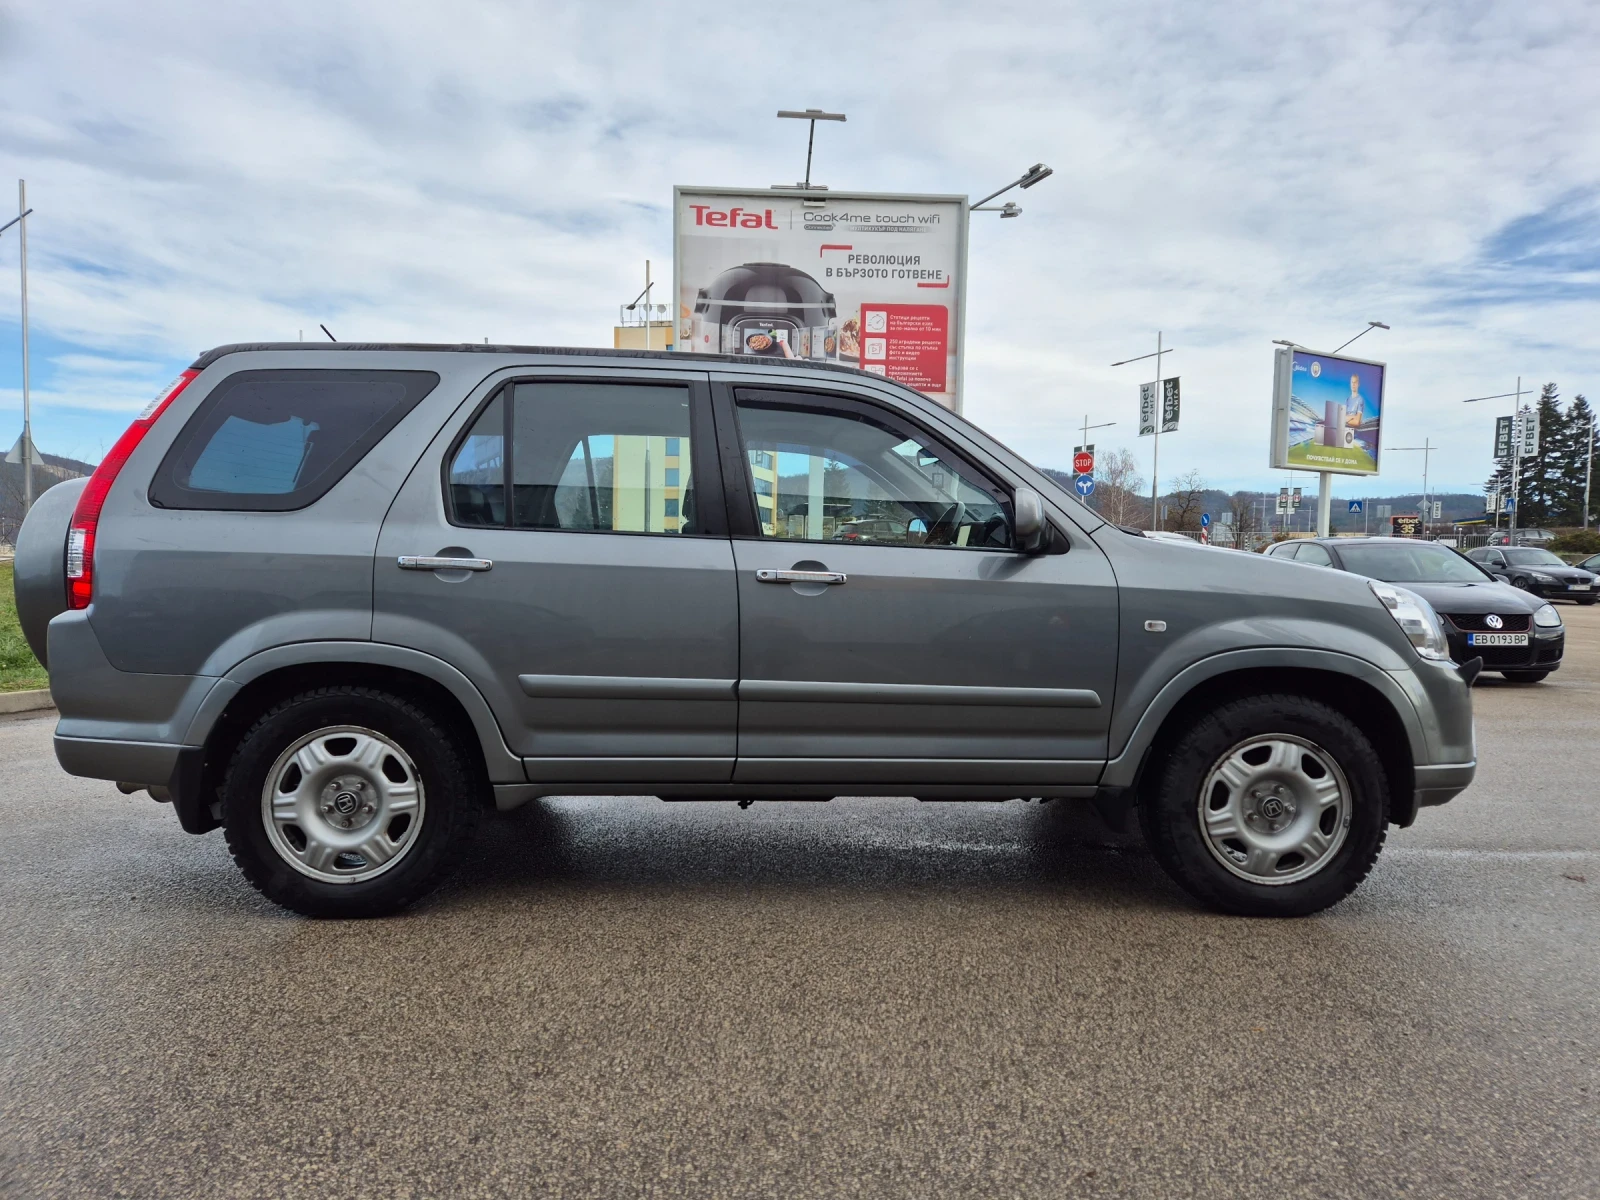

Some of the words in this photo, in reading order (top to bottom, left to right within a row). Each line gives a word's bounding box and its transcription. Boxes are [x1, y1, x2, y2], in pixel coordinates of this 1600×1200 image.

[689, 204, 778, 230] Tefal
[804, 211, 871, 223] Cook4me
[875, 214, 914, 224] touch
[918, 215, 940, 225] wifi
[848, 254, 921, 268] РЕВОЛЮЦИЯ
[826, 268, 833, 279] В
[836, 268, 888, 280] БЪРЗОТО
[891, 269, 942, 281] ГОТВЕНЕ
[1165, 381, 1174, 420] efbet
[1498, 419, 1509, 456] EFBET
[1524, 417, 1535, 454] EFBET
[1075, 458, 1092, 468] STOP
[1401, 524, 1415, 534] 35
[1475, 634, 1488, 645] EB
[1489, 634, 1513, 645] 0193
[1514, 634, 1527, 645] BP
